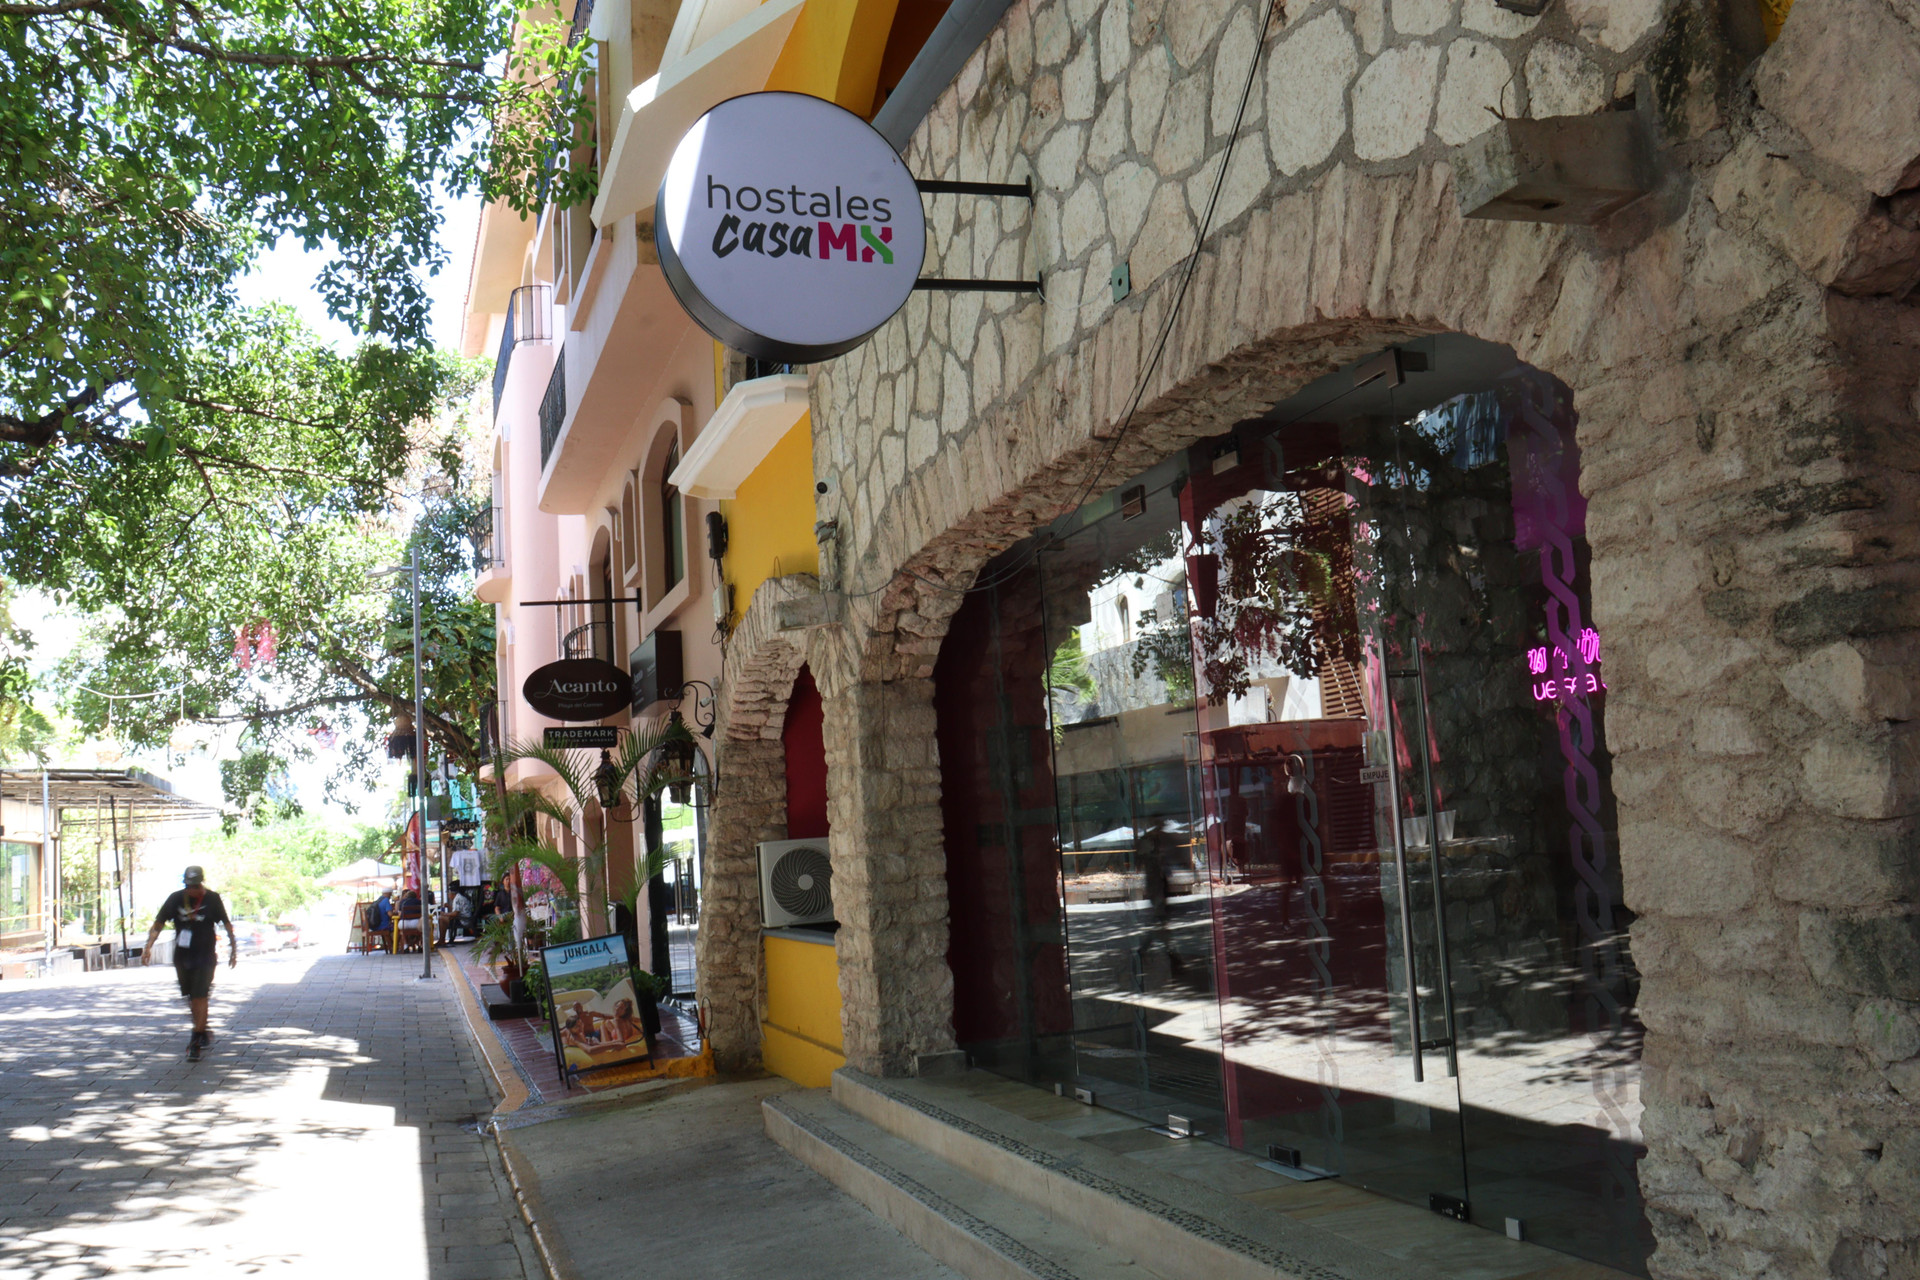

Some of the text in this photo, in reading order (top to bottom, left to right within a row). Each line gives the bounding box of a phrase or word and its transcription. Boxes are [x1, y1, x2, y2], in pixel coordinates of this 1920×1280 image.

[707, 174, 892, 222] hostales
[540, 678, 618, 697] Acanto
[548, 729, 614, 738] TRADEMARK
[1362, 769, 1389, 780] EMPUJE
[444, 821, 476, 831] ACANTO
[449, 838, 473, 847] HOTEL
[560, 941, 613, 964] JUNGALA
